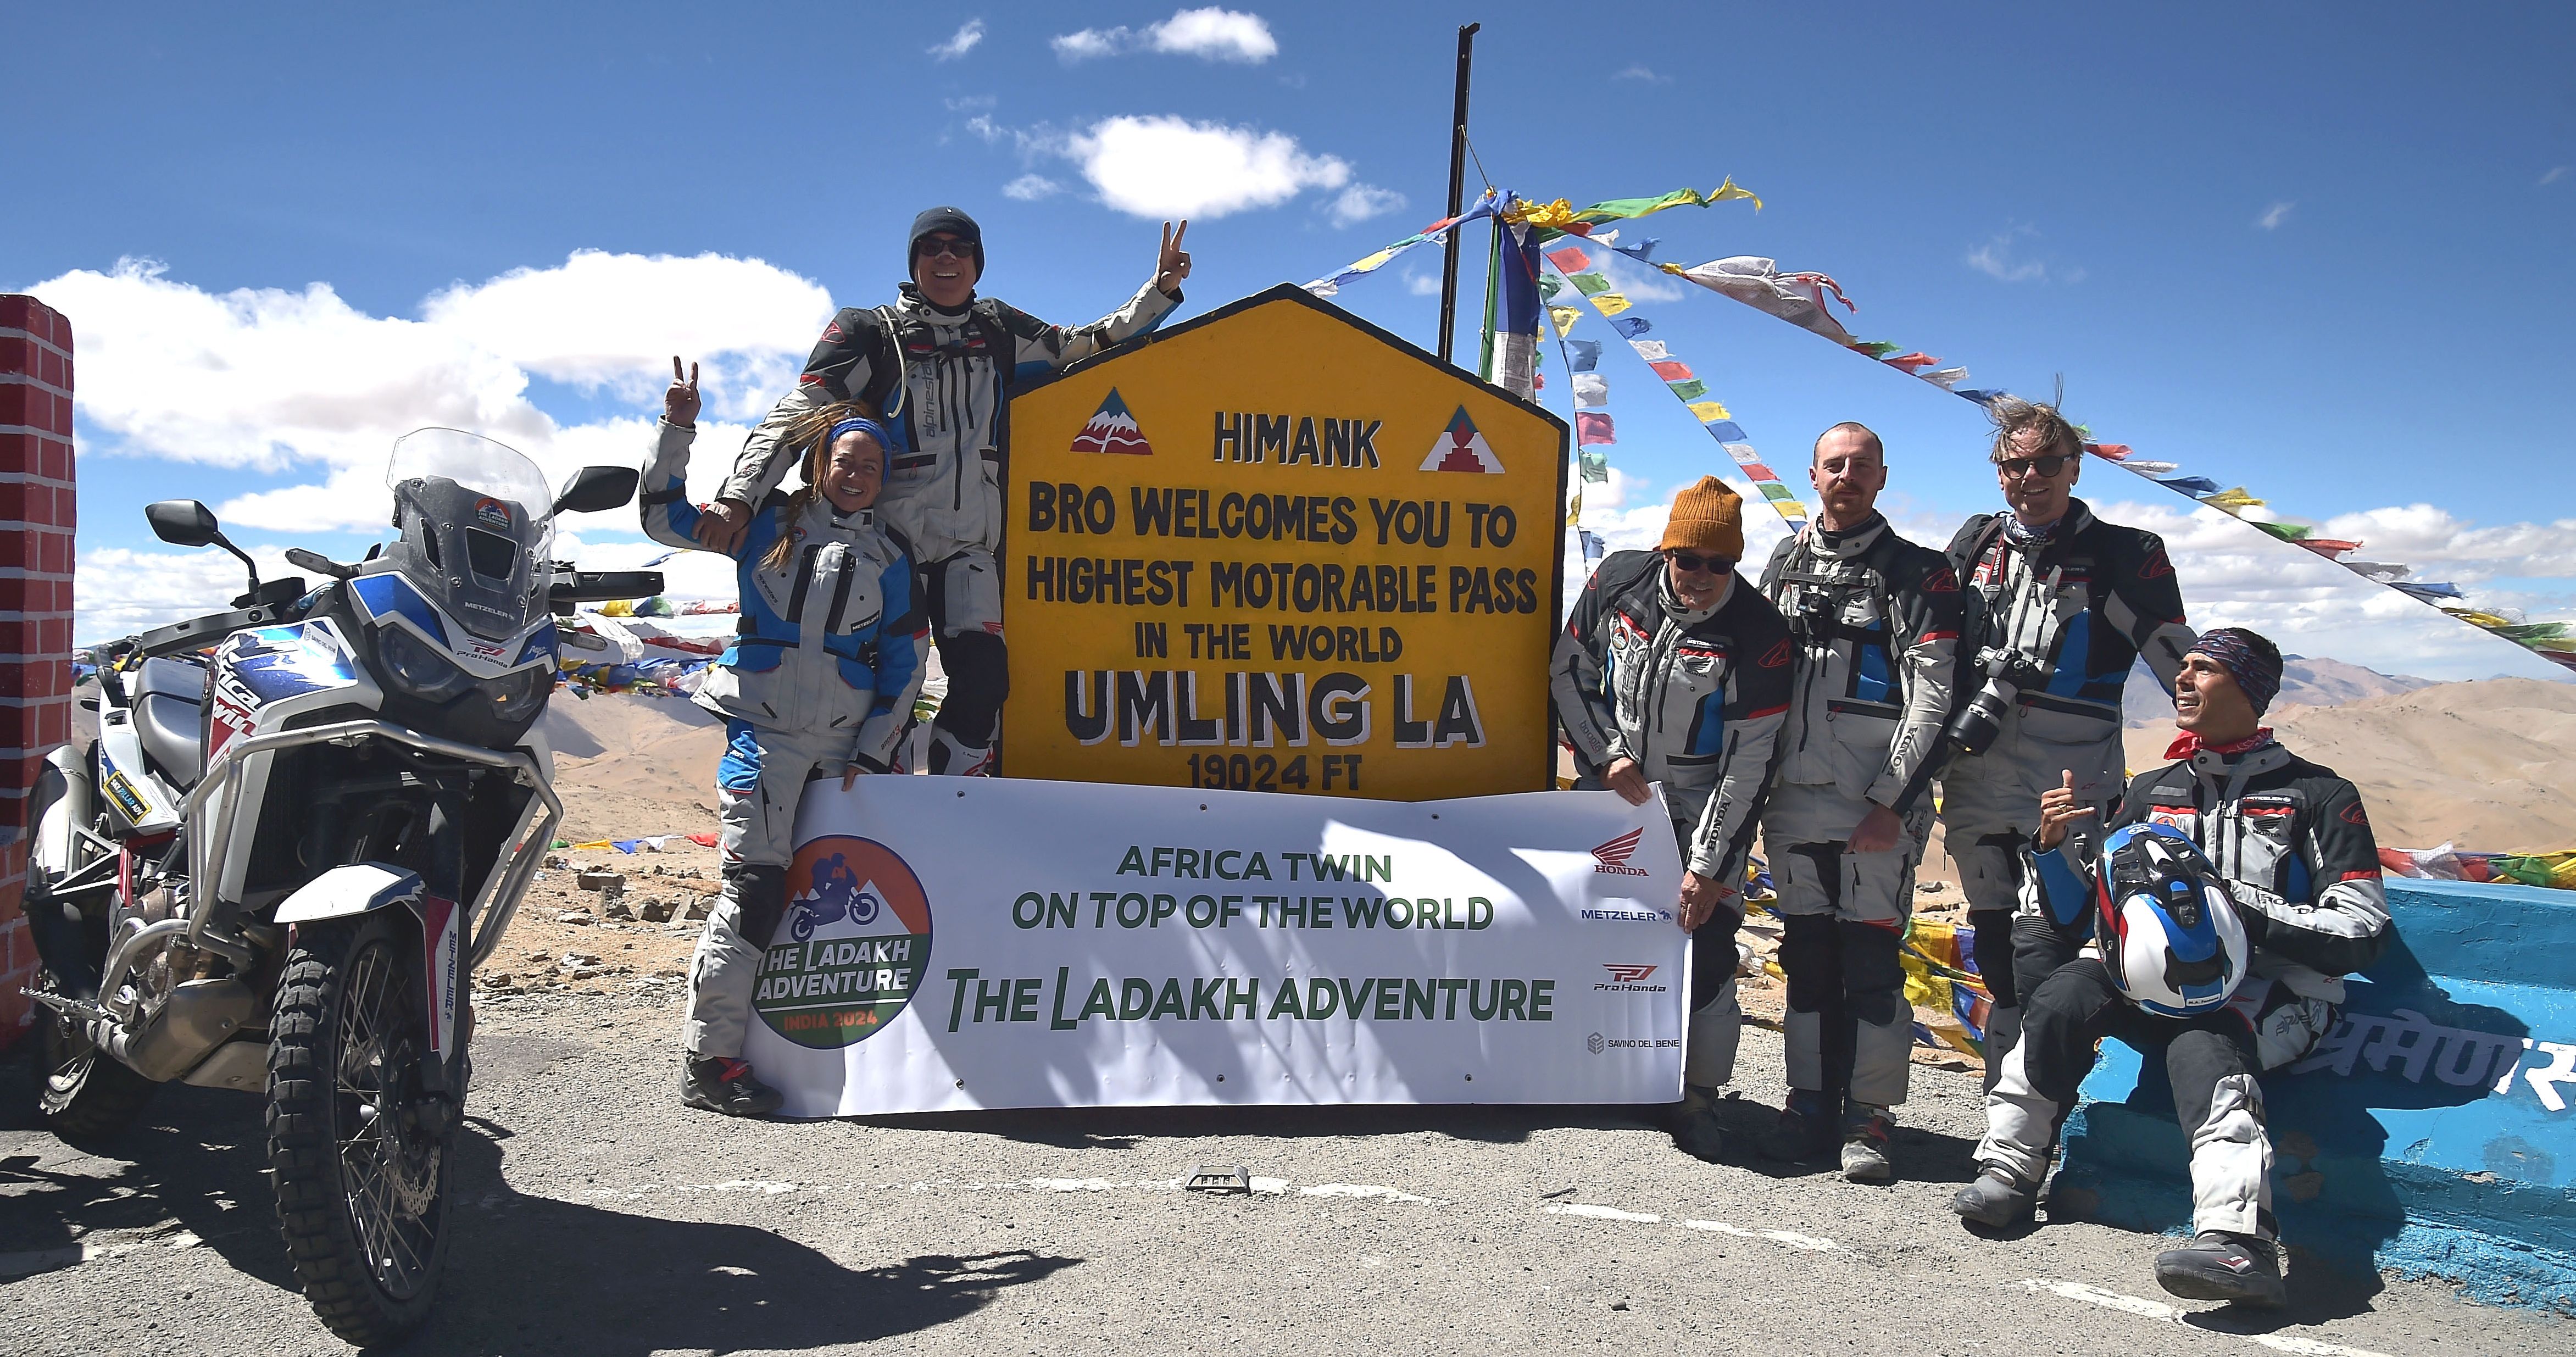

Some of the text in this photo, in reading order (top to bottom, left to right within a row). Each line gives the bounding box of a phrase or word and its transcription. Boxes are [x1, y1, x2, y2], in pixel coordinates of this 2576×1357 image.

[1214, 411, 1382, 469] HIMANK
[1028, 481, 1517, 548] BRO WELCOMES YOU TO
[1992, 546, 2004, 576] Canon
[1027, 555, 1538, 614] HIGHEST MOTORABLE PASS
[465, 602, 508, 618] METZELER
[1135, 622, 1403, 662] IN THE WORLD
[1685, 669, 1708, 678] HONDA
[1064, 669, 1487, 748] UMLING LA
[1886, 726, 1919, 778] HONDA
[1187, 753, 1363, 791] 19024 FT
[110, 779, 122, 791] SKY
[120, 788, 135, 807] PILLAR
[131, 804, 144, 815] ADV
[1707, 800, 1732, 852] HONDA
[2252, 828, 2282, 838] HONDA
[1116, 844, 1392, 883] AFRICA TWIN
[1594, 865, 1649, 877] HONDA
[1012, 891, 1495, 931] ON TOP OF THE WORLD
[1581, 909, 1656, 921] METZELER
[444, 930, 457, 1010] METZELER
[757, 938, 912, 976] THE LADAKH
[756, 968, 912, 1001] ADVENTURE
[946, 966, 1555, 1033] THE LADAKH ADVENTURE
[784, 1010, 878, 1031] INDIA 2024
[1607, 1039, 1680, 1048] SAVINO DEL BENE
